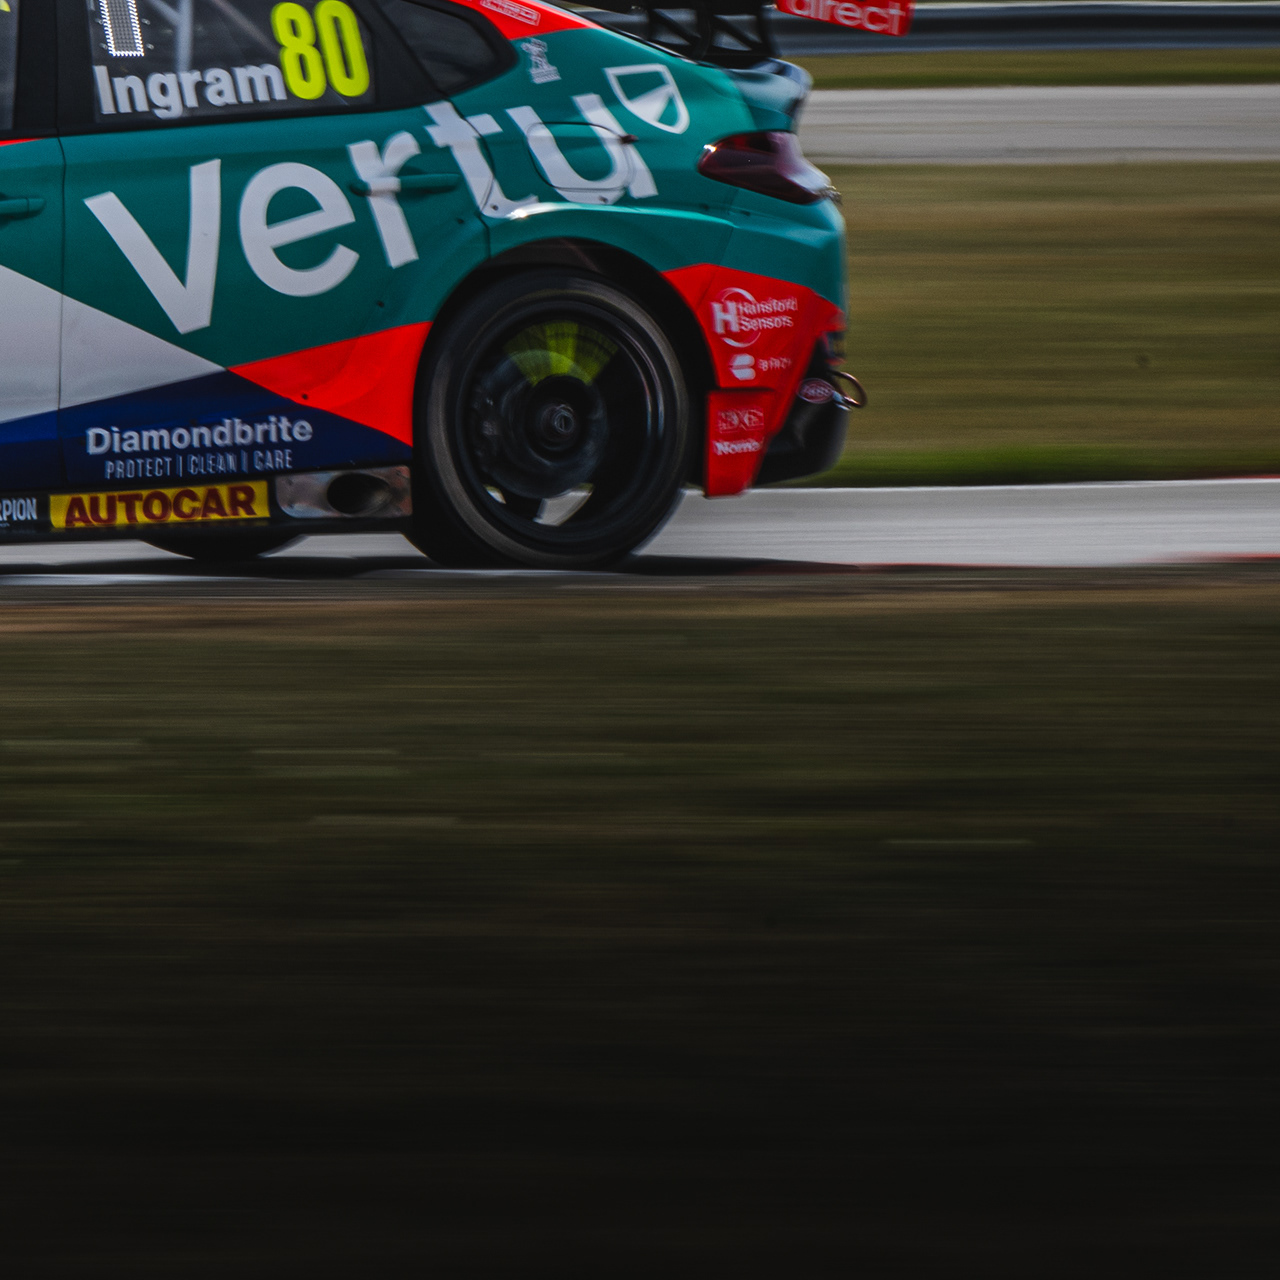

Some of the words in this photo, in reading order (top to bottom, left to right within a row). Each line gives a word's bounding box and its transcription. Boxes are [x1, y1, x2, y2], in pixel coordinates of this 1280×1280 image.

[270, 0, 370, 100] 80
[93, 63, 288, 119] Ingram
[84, 93, 658, 334] vertu
[710, 300, 740, 334] H
[738, 297, 799, 314] Hansford
[740, 315, 794, 331] Sensors
[86, 415, 313, 455] Diamondbrite
[105, 457, 172, 480] PROTECT
[190, 451, 237, 476] CLEAN
[253, 449, 293, 470] CARE
[64, 484, 257, 527] AUTOCAR
